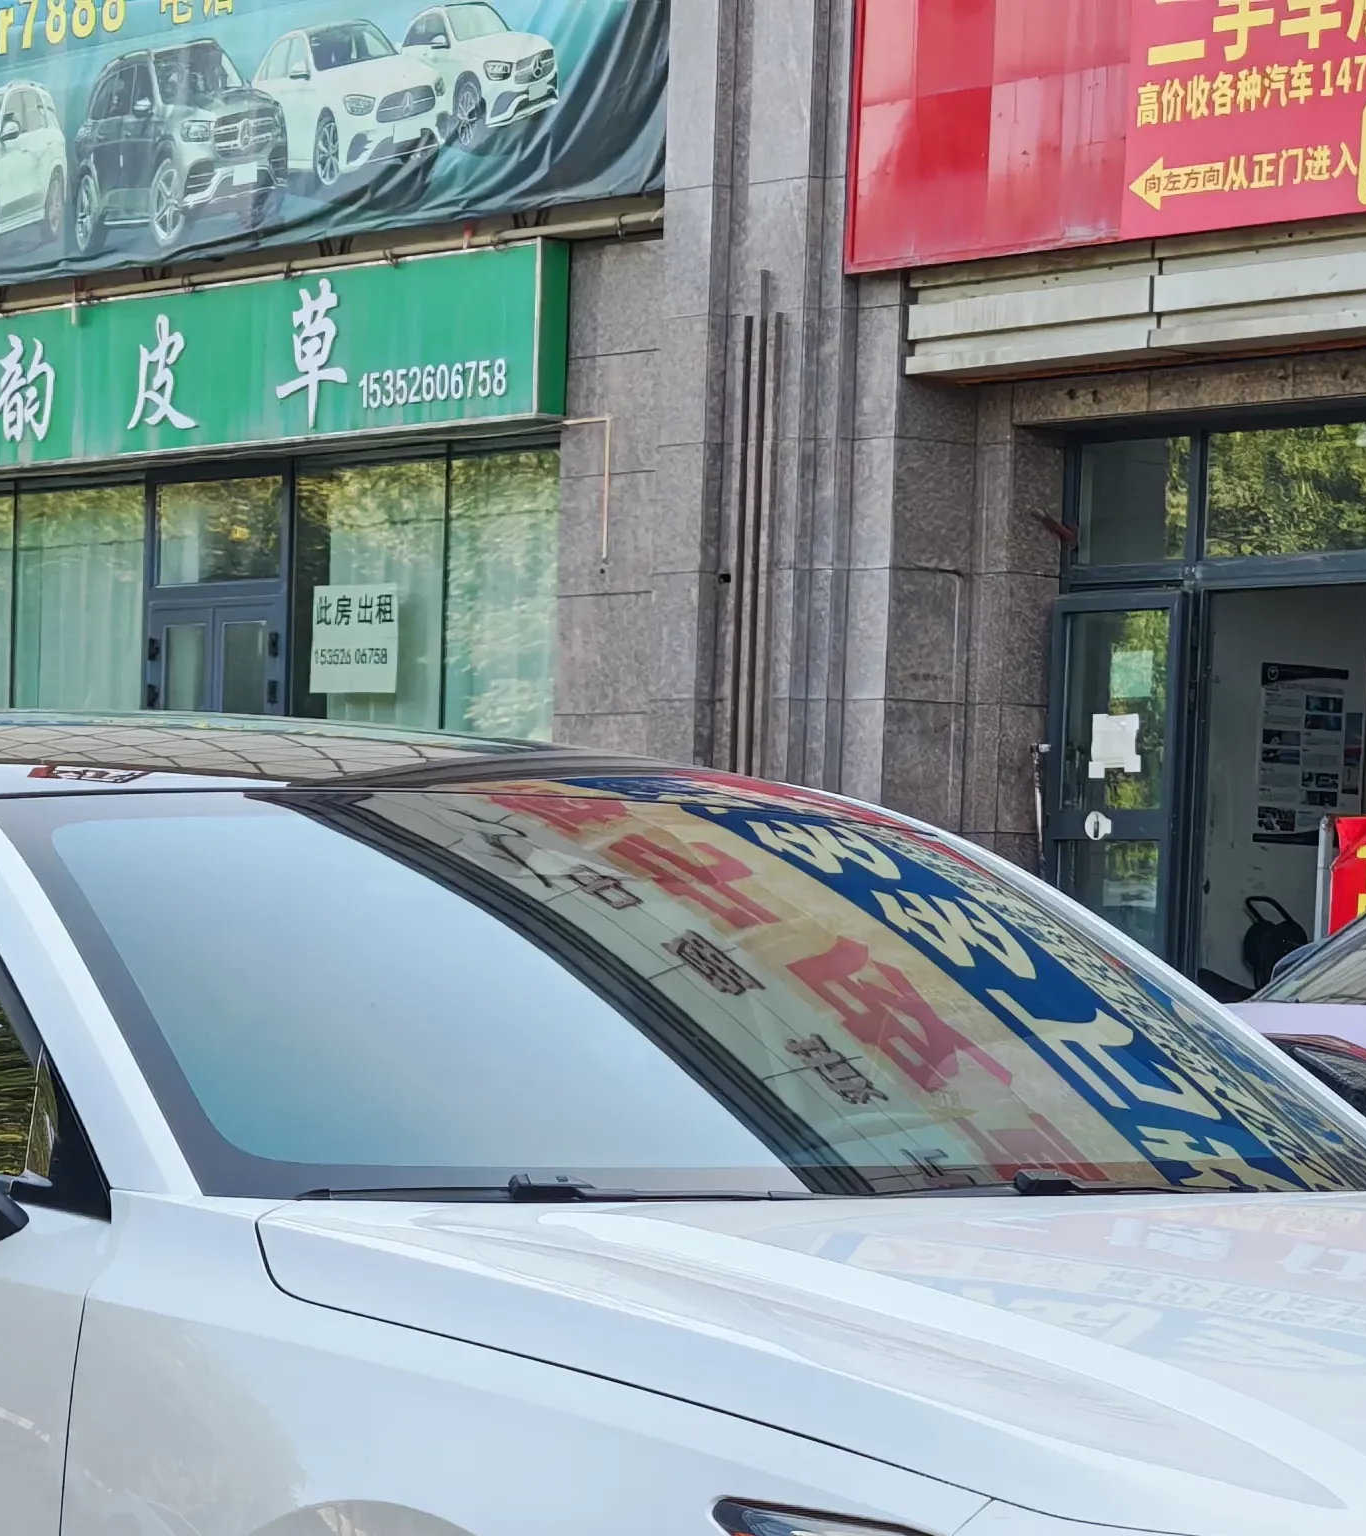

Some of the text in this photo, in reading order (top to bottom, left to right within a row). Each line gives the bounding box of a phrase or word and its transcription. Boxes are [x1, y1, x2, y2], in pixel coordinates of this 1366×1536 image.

[1136, 59, 1314, 128] 高价收各种汽车
[1143, 142, 1359, 194] 向左方向 从正门进入
[358, 359, 508, 410] 15352606758
[316, 594, 395, 626] 此房出租
